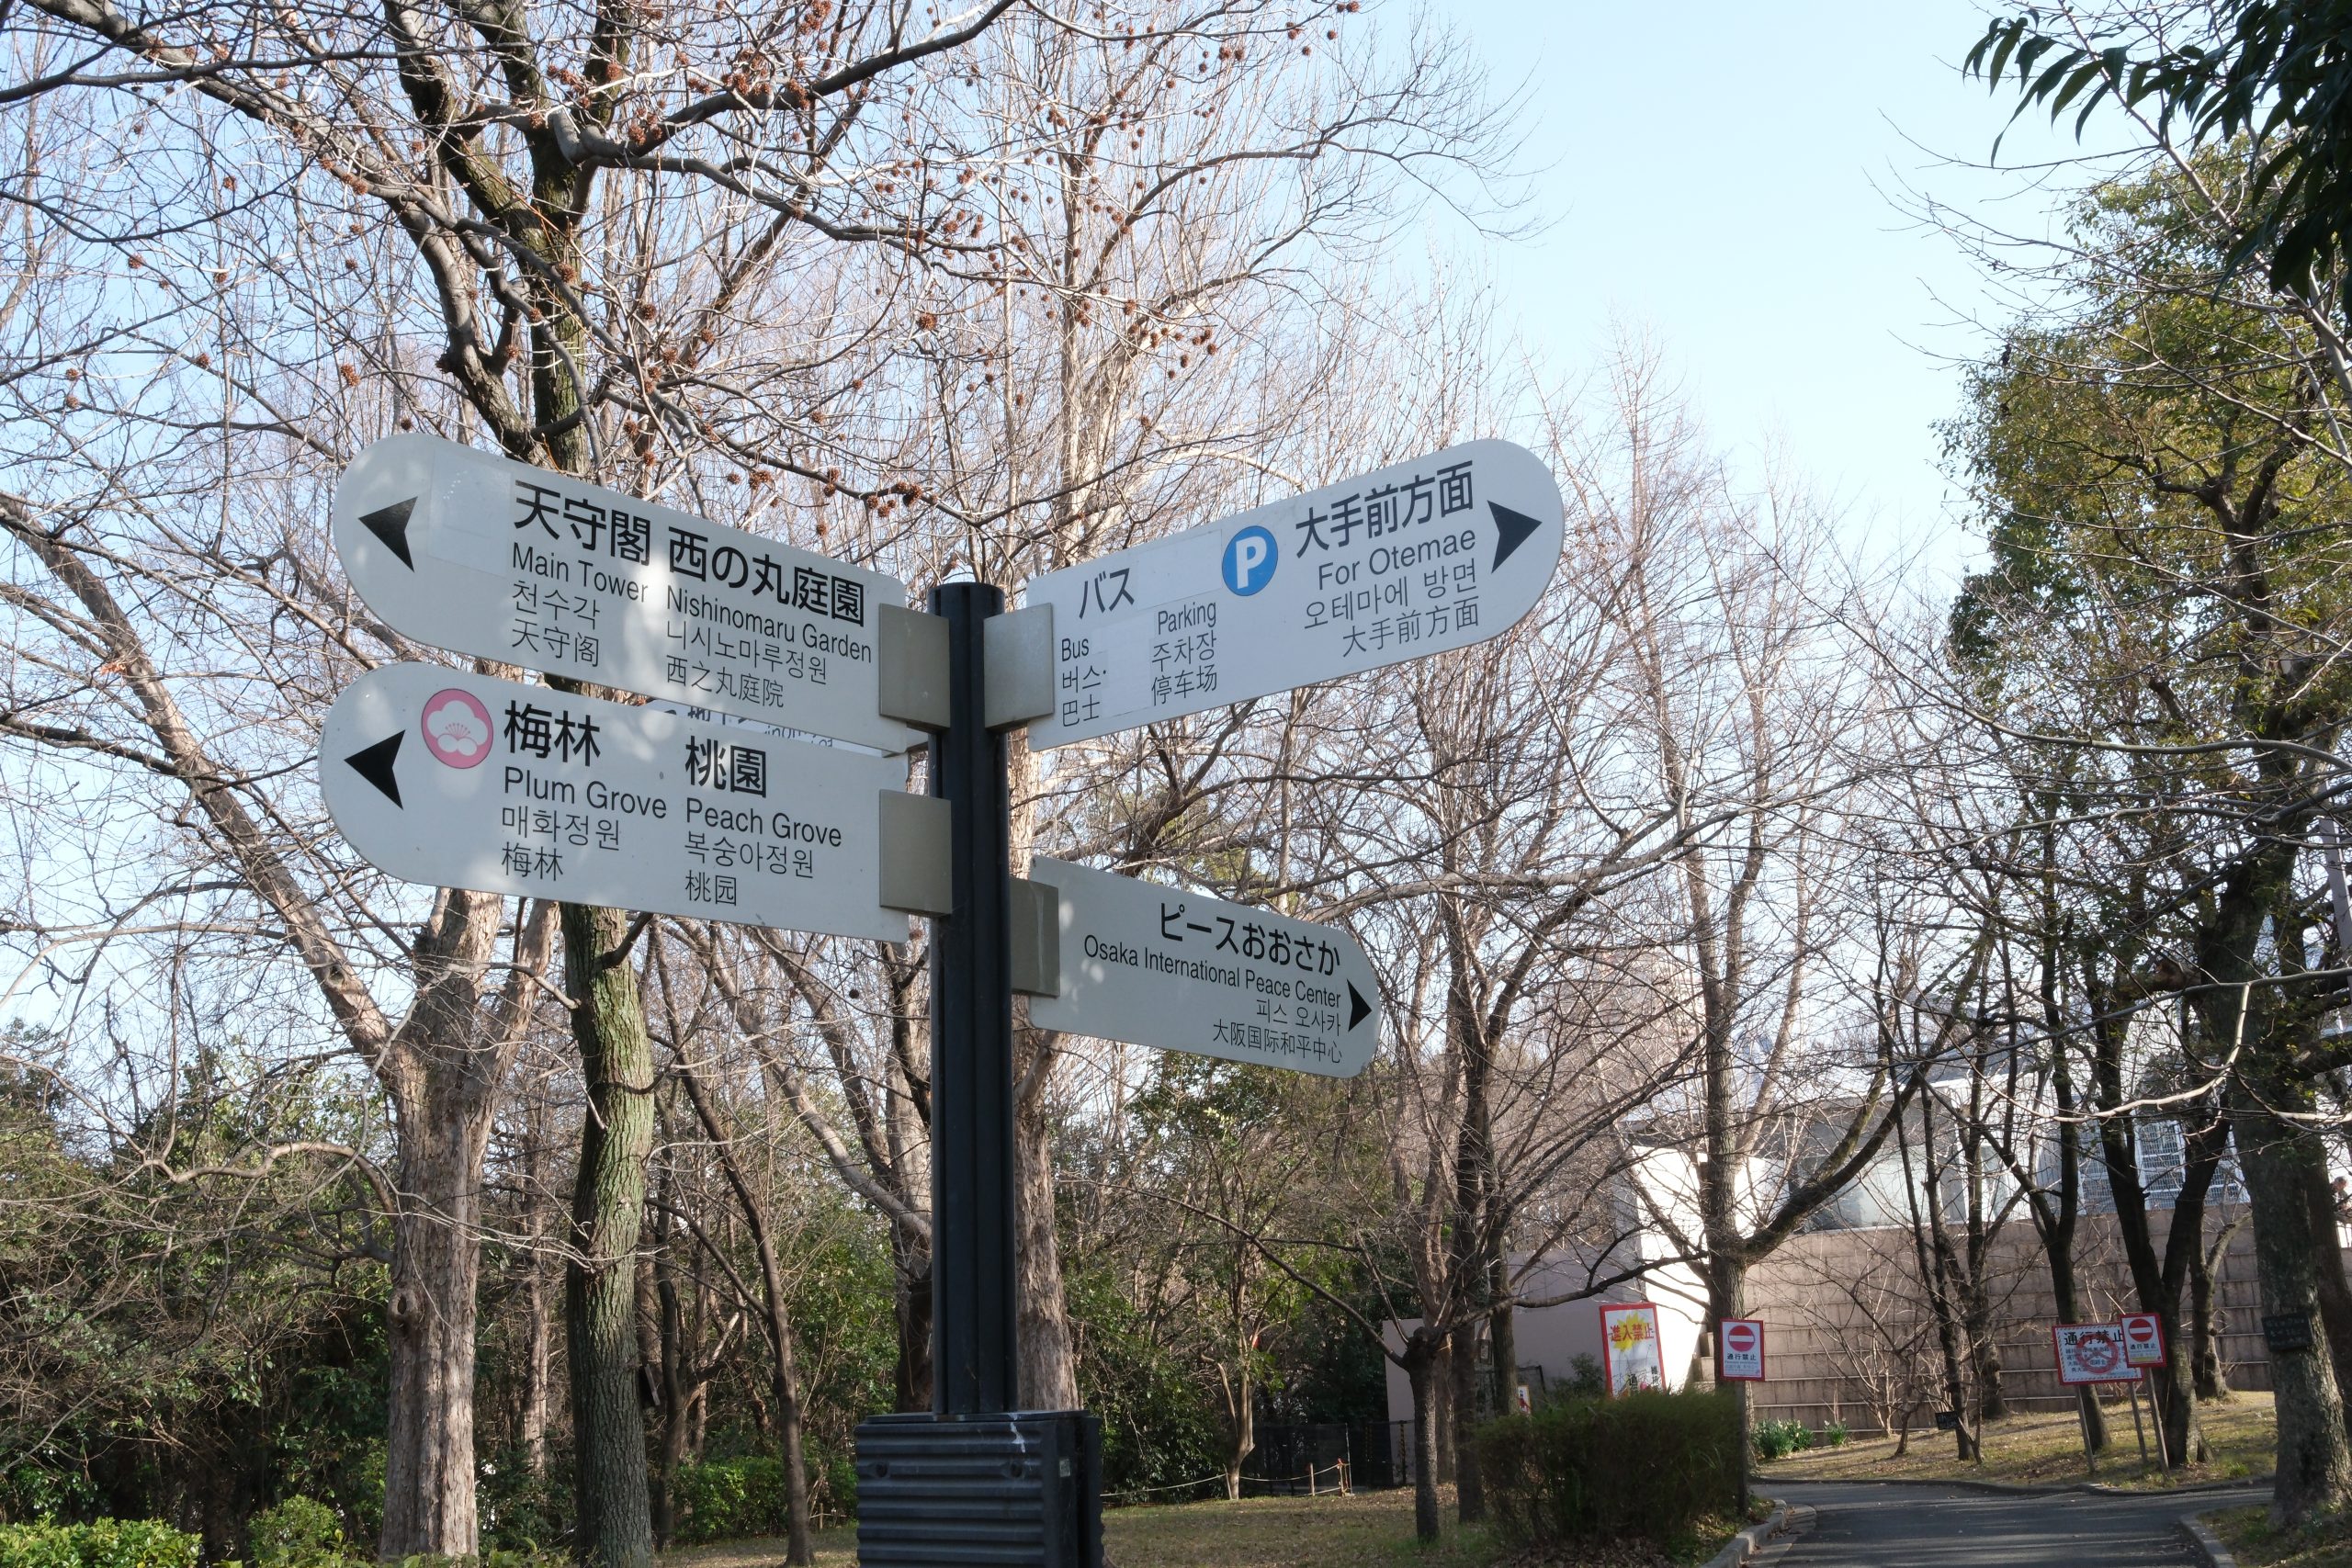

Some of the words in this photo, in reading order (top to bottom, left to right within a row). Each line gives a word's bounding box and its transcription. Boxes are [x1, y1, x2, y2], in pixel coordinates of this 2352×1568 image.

[514, 479, 650, 566] 天守閣
[1295, 461, 1474, 558] 大手前方面
[513, 542, 570, 582] Main
[578, 559, 649, 604] Tower
[668, 525, 865, 627] 西の丸庭園
[1236, 536, 1267, 588] P
[1318, 559, 1361, 591] For
[1369, 529, 1476, 575] Otemae
[512, 581, 600, 630] 천수각
[1079, 568, 1135, 619] バス
[1158, 602, 1216, 634] Parking
[1305, 576, 1409, 629] 오테마에
[1423, 558, 1476, 597] 방면
[512, 618, 600, 668] 天守阁
[667, 584, 794, 646] Nishinomaru
[802, 623, 872, 664] Garden
[1061, 637, 1090, 662] Bus
[1342, 595, 1478, 658] 大手前方面
[667, 621, 827, 685] 니시노마루정원
[1151, 631, 1216, 671] 주차장
[667, 655, 784, 707] 西之丸庭院
[1151, 663, 1217, 706] 停车场
[504, 700, 600, 767] 梅林
[1062, 694, 1101, 728] 巴士
[504, 767, 575, 804] Plum
[586, 780, 667, 818] Grove
[685, 736, 766, 798] 桃園
[502, 805, 620, 852] 매화정원
[686, 797, 763, 835] Peach
[772, 812, 842, 848] Grove
[502, 841, 563, 882] 梅林
[684, 830, 814, 879] 복숭아정원
[684, 869, 737, 907] 桃园
[1161, 902, 1340, 976] ピースおおさか
[1084, 934, 1138, 967] Osaka
[1145, 947, 1240, 987] International
[1246, 969, 1290, 998] Peace
[1295, 980, 1341, 1009] Center
[1213, 1019, 1342, 1064] 大阪国际和平中心
[1256, 998, 1288, 1023] 피스
[1295, 1006, 1340, 1037] 오사카
[1610, 1323, 1654, 1342] 進入禁止
[2064, 1329, 2124, 1346] 通行禁止
